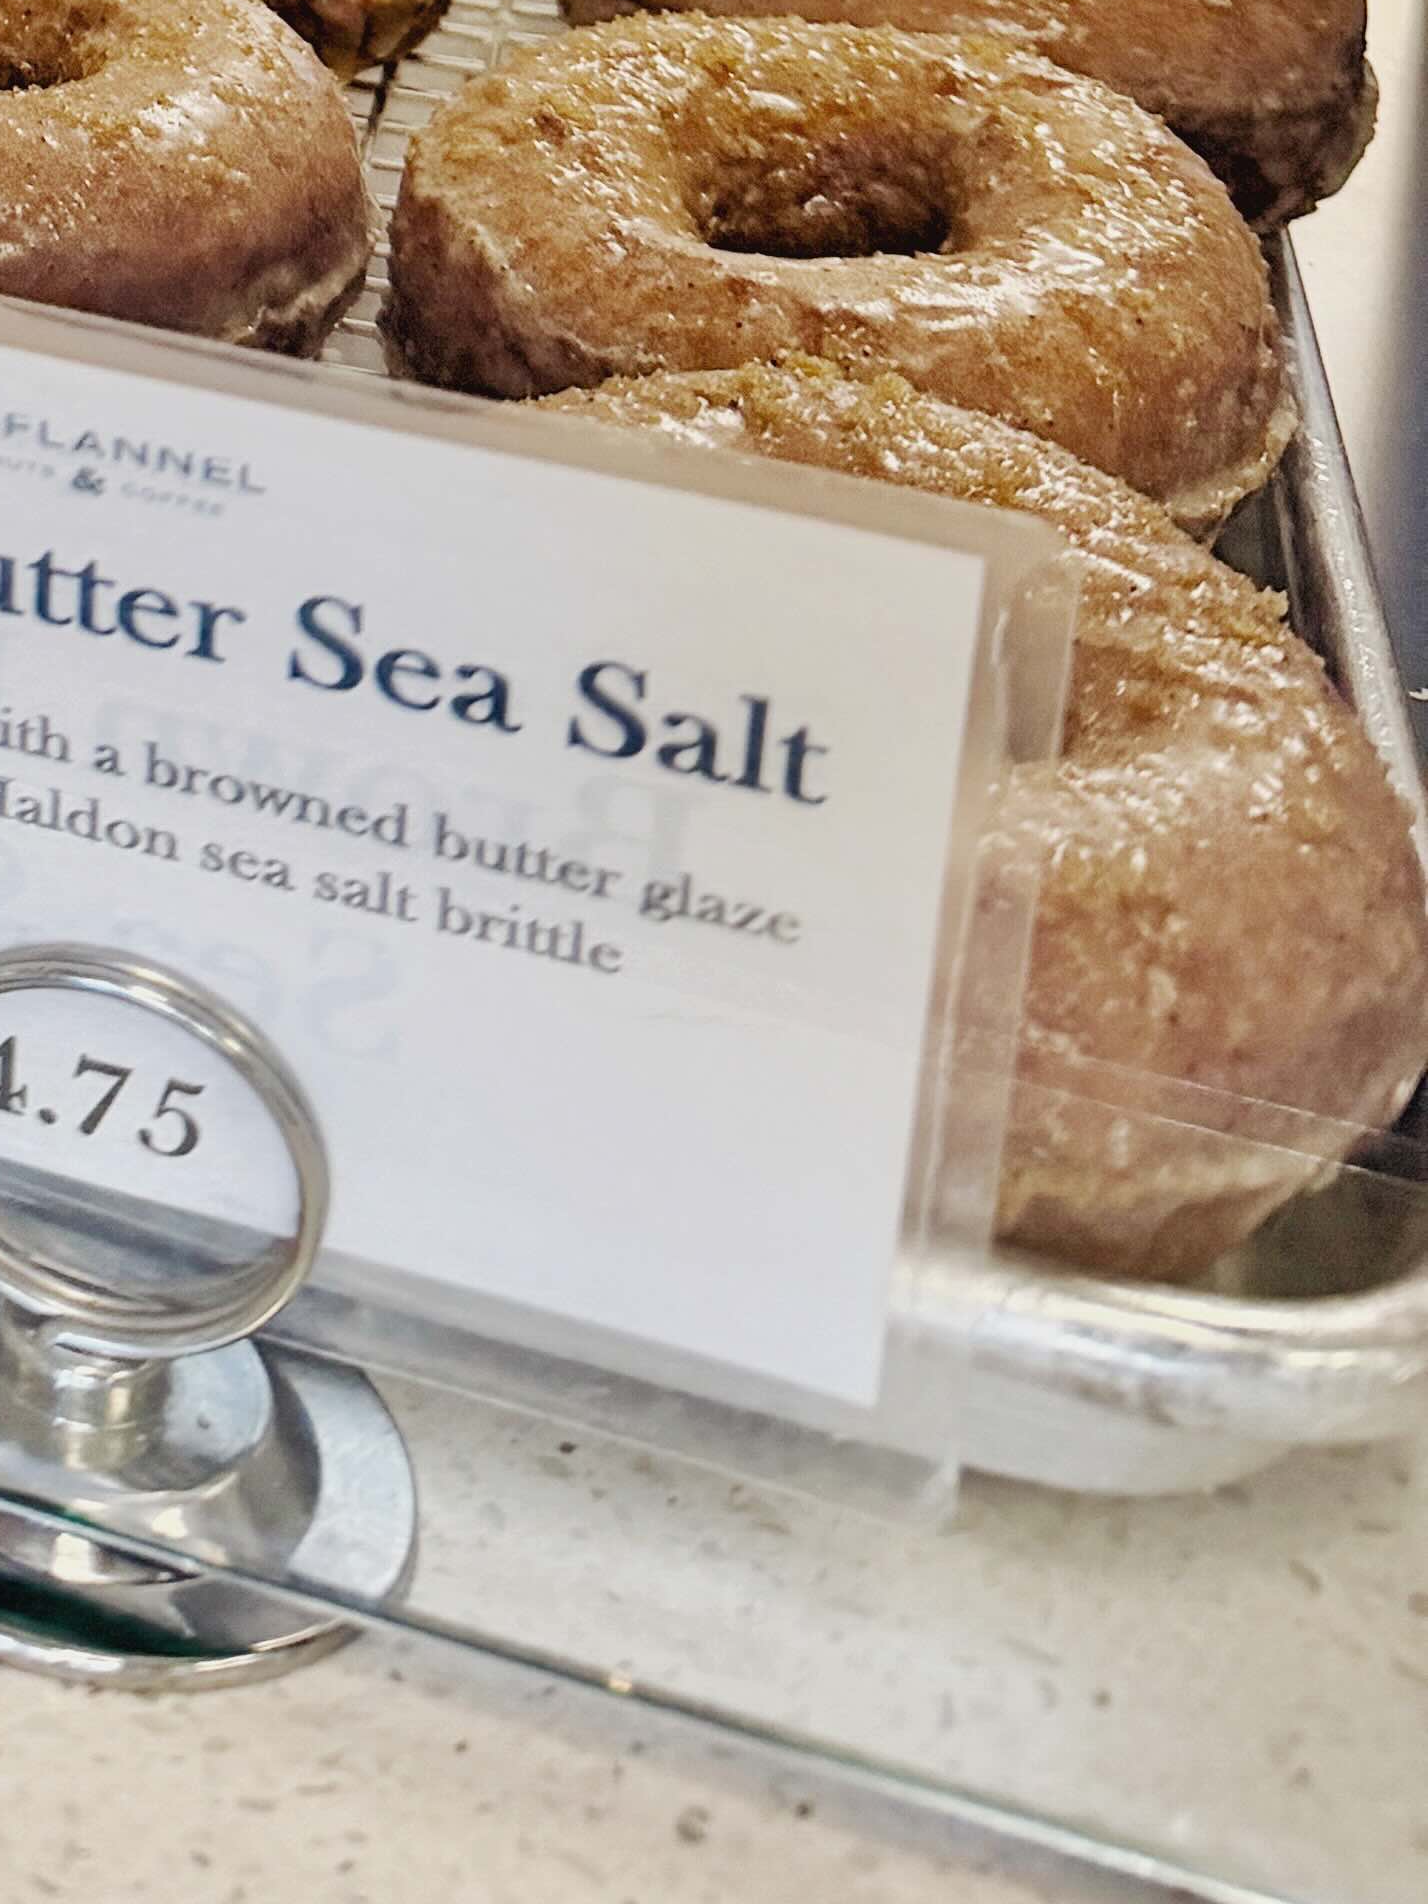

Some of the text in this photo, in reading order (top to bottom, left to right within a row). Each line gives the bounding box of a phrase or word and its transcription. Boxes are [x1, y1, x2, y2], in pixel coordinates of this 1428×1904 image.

[2, 411, 268, 496] FLANNEL
[70, 466, 106, 498] &
[287, 593, 523, 734] Sea
[565, 658, 831, 807] Salt
[92, 741, 128, 778] a
[144, 738, 411, 849] browned
[432, 812, 626, 900] butter
[640, 872, 805, 948] glaze
[198, 841, 296, 892] sea
[312, 870, 419, 923] salt
[435, 887, 626, 976] brittle
